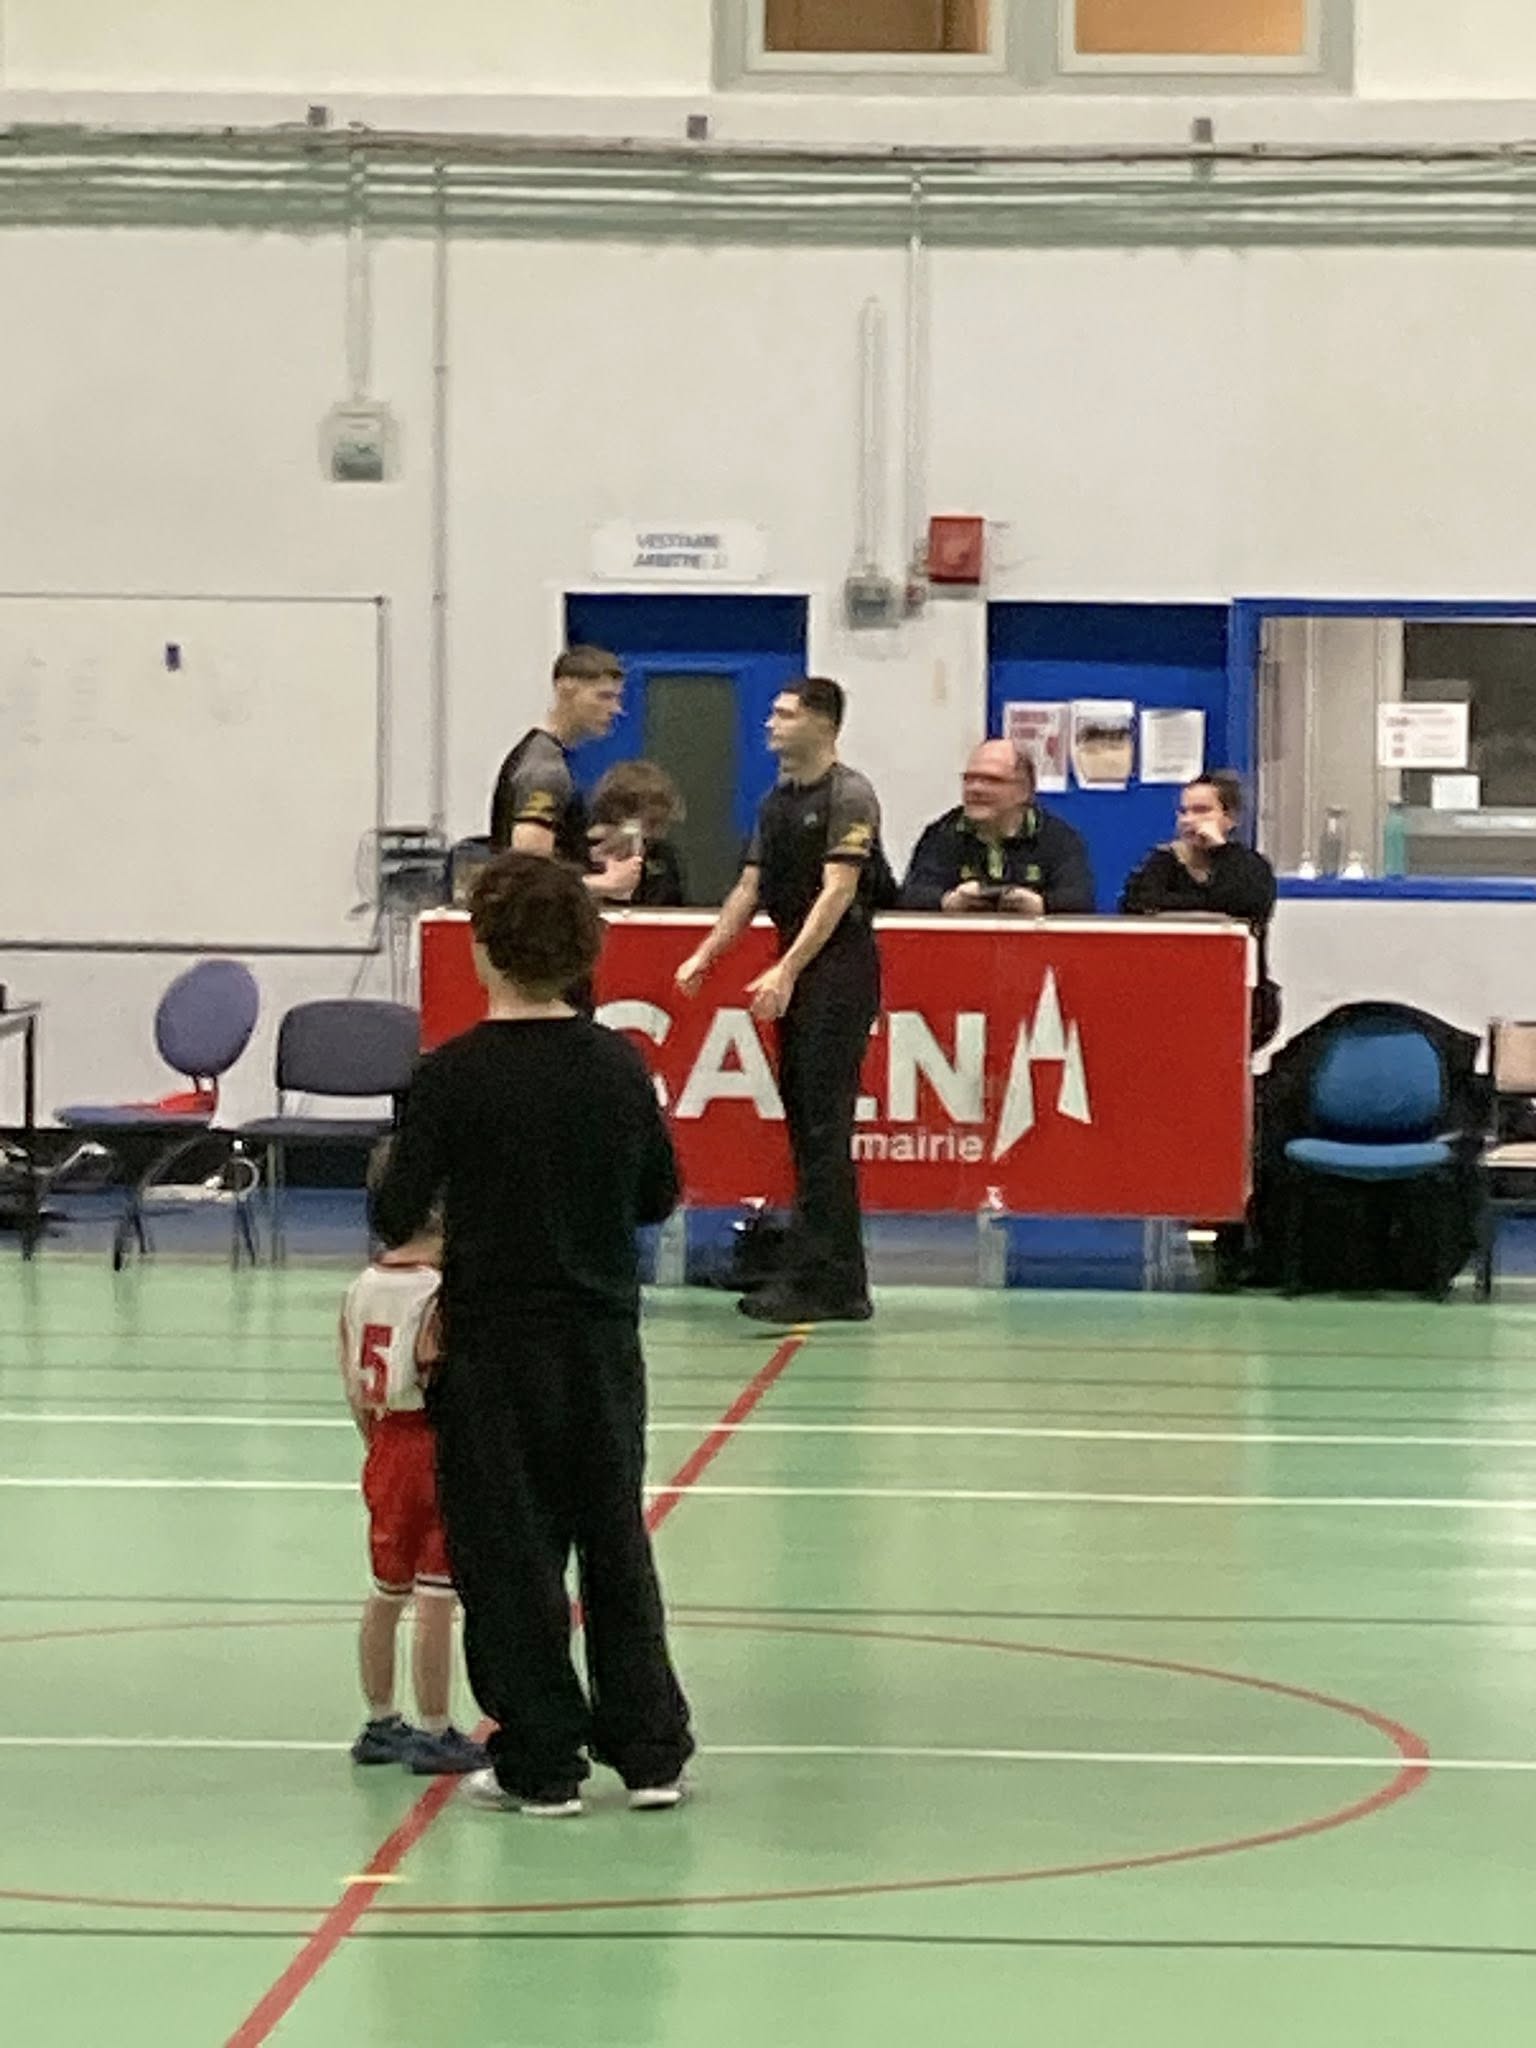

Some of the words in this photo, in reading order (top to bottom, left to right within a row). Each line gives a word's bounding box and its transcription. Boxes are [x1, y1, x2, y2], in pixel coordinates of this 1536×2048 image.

[594, 1000, 986, 1123] CAN
[851, 1127, 984, 1162] mairie
[361, 1324, 392, 1404] 5
